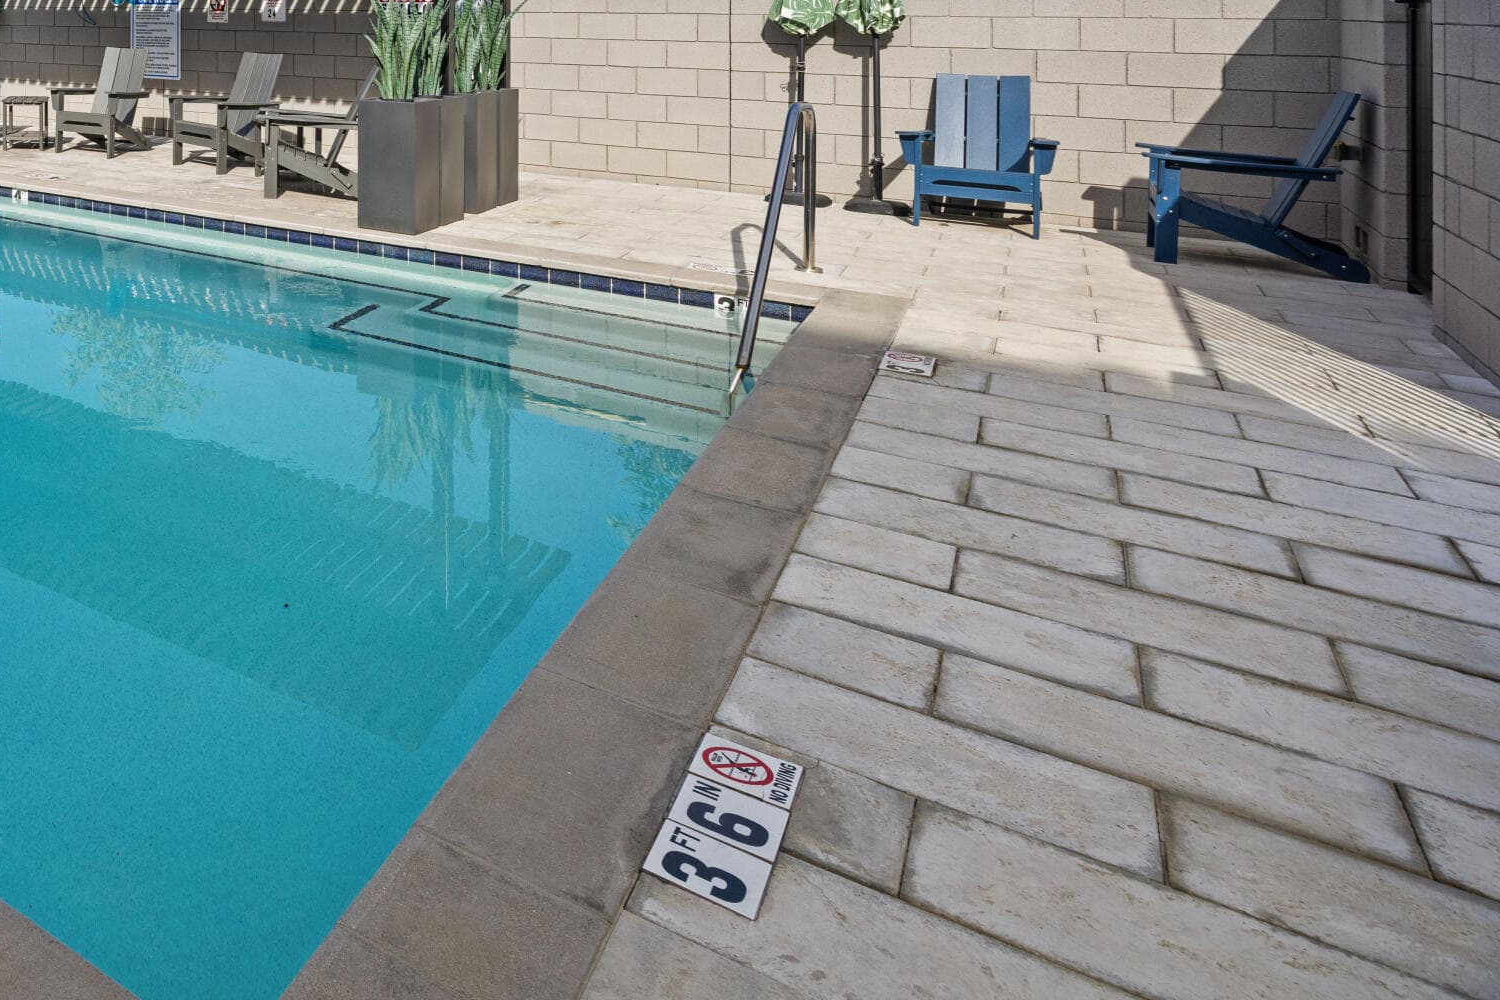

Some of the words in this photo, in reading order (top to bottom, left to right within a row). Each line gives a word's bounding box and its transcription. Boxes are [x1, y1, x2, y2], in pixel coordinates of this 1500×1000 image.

[267, 9, 277, 19] 24
[718, 296, 735, 312] 3
[773, 762, 797, 792] DIVING
[692, 780, 722, 801] IN
[768, 789, 789, 804] NO
[686, 801, 769, 847] 6
[669, 826, 701, 853] FT
[662, 850, 747, 903] 3
